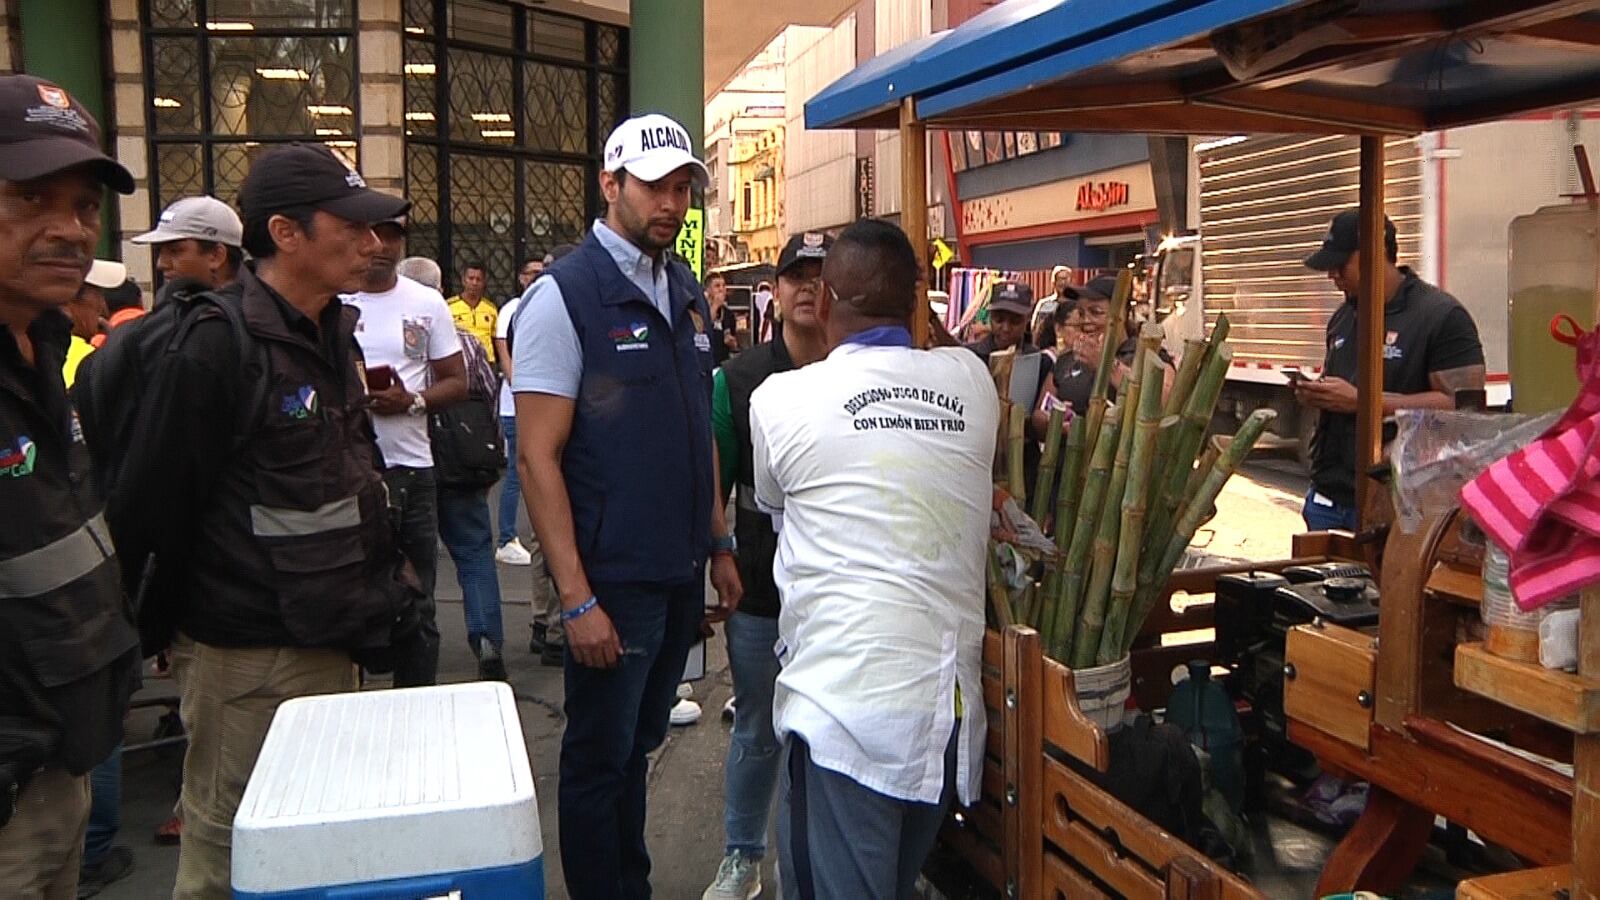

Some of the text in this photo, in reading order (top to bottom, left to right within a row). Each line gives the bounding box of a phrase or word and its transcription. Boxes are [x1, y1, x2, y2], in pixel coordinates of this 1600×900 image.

[922, 389, 936, 404] DE
[937, 394, 964, 416] CAÑA
[854, 414, 965, 432] CON LIMÓN BIEN FRIO
